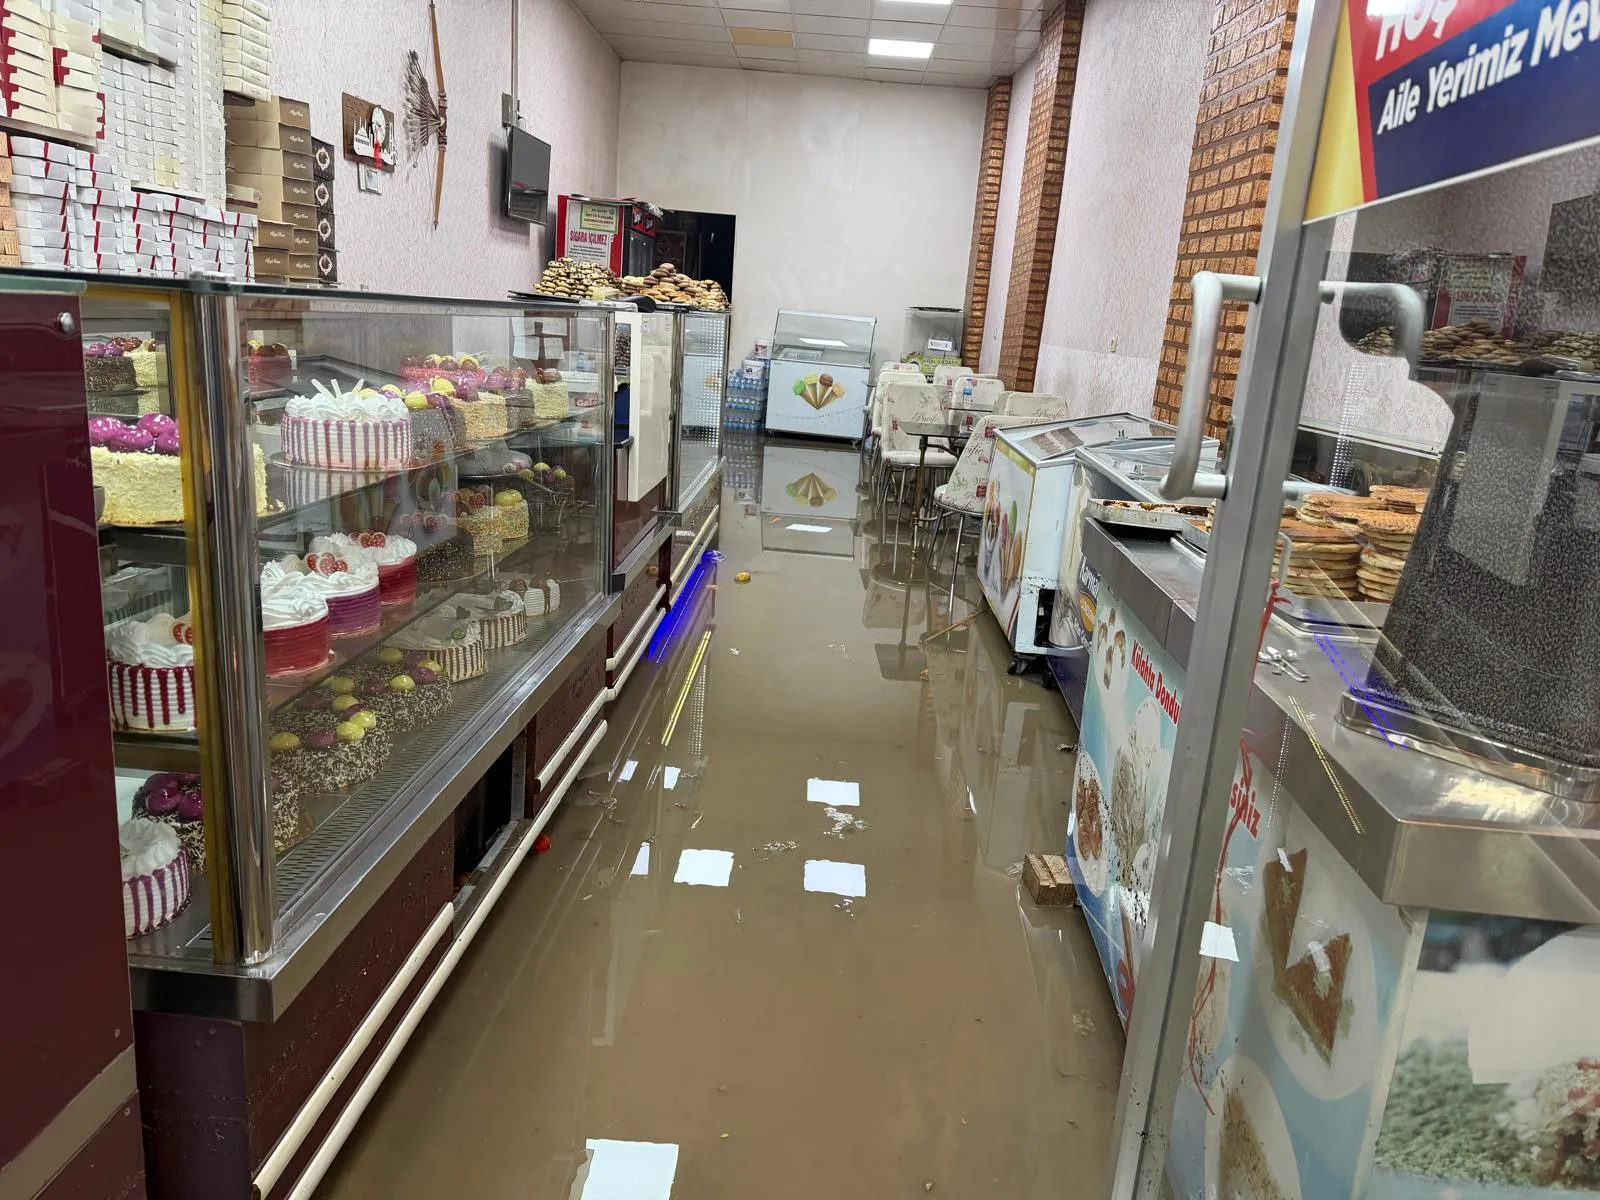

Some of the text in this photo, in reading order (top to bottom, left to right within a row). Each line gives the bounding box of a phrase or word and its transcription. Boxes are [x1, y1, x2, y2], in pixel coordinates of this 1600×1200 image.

[1377, 77, 1420, 136] Aile
[1426, 24, 1530, 114] Yerimiz
[1130, 639, 1156, 692] Külahta
